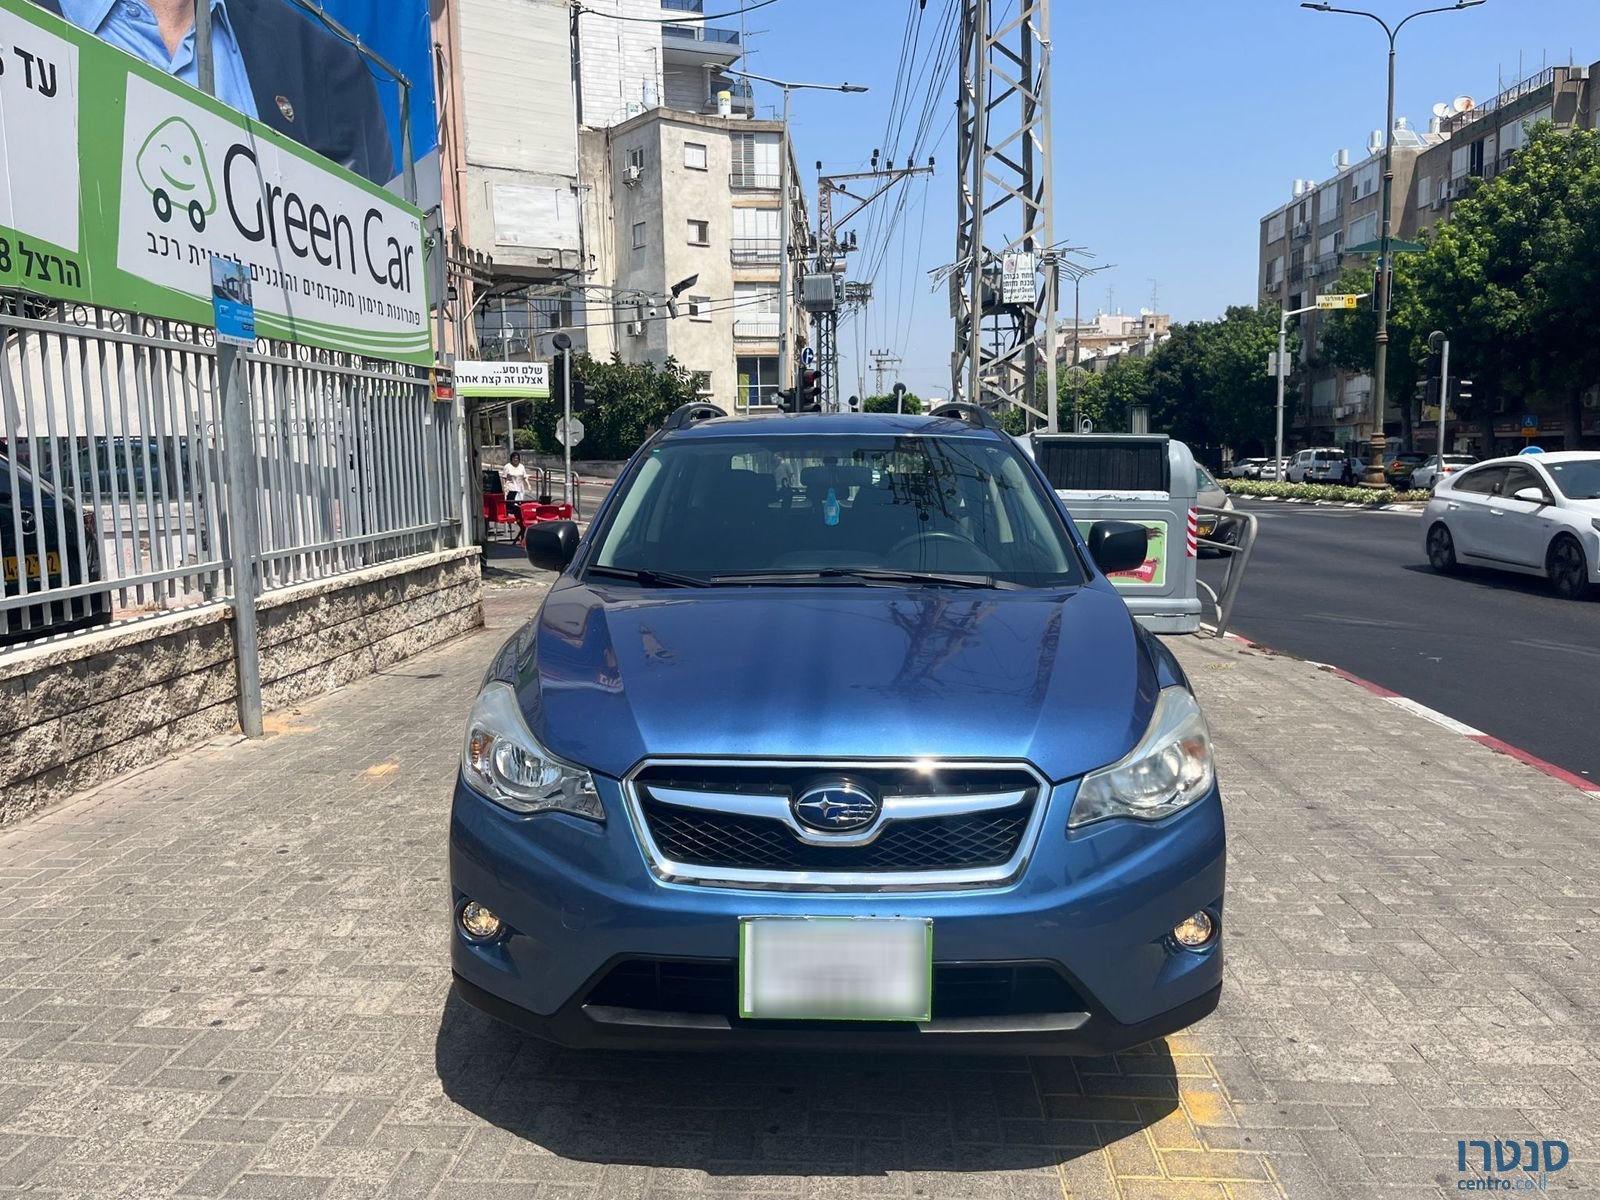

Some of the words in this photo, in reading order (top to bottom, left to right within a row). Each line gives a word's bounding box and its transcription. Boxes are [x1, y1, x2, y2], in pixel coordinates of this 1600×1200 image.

[13, 45, 57, 97] עד
[224, 143, 356, 274] Green
[363, 208, 413, 293] Car
[147, 231, 181, 260] רכב
[18, 240, 81, 288] הרצל
[249, 262, 298, 292] והוגנים
[303, 278, 355, 308] מתקדמים
[358, 295, 384, 316] מימון
[386, 303, 420, 326] פתרונות
[481, 375, 501, 386] קצת
[504, 376, 515, 384] זה
[517, 375, 543, 384] אצלנו
[521, 365, 543, 374] שלם
